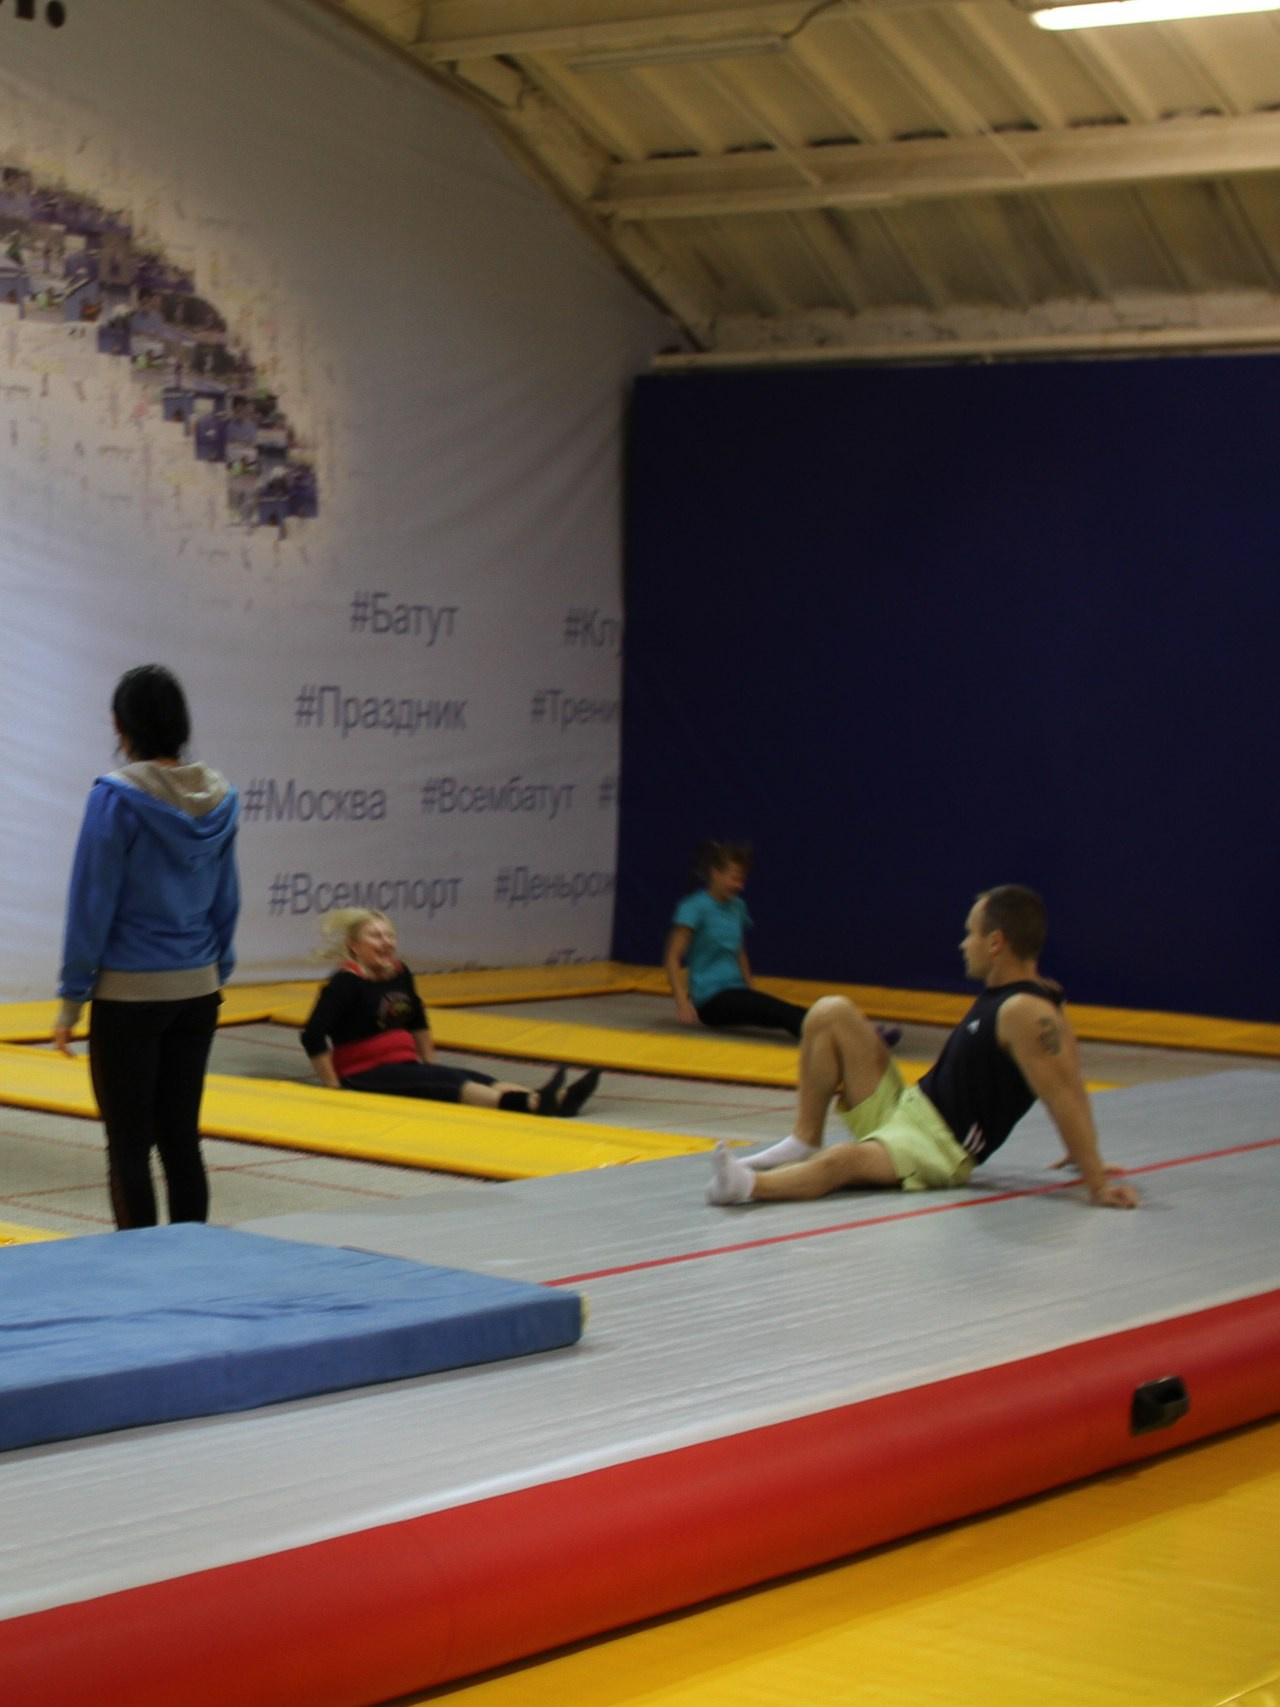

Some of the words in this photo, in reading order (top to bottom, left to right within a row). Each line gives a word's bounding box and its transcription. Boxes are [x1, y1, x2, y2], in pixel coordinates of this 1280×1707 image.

[350, 590, 458, 646] #Батут
[563, 606, 622, 658] #Кл
[294, 686, 467, 738] #Праздник
[244, 779, 387, 822] #Москва
[421, 776, 575, 820] #Всембатут
[268, 872, 463, 919] #Всемспорт
